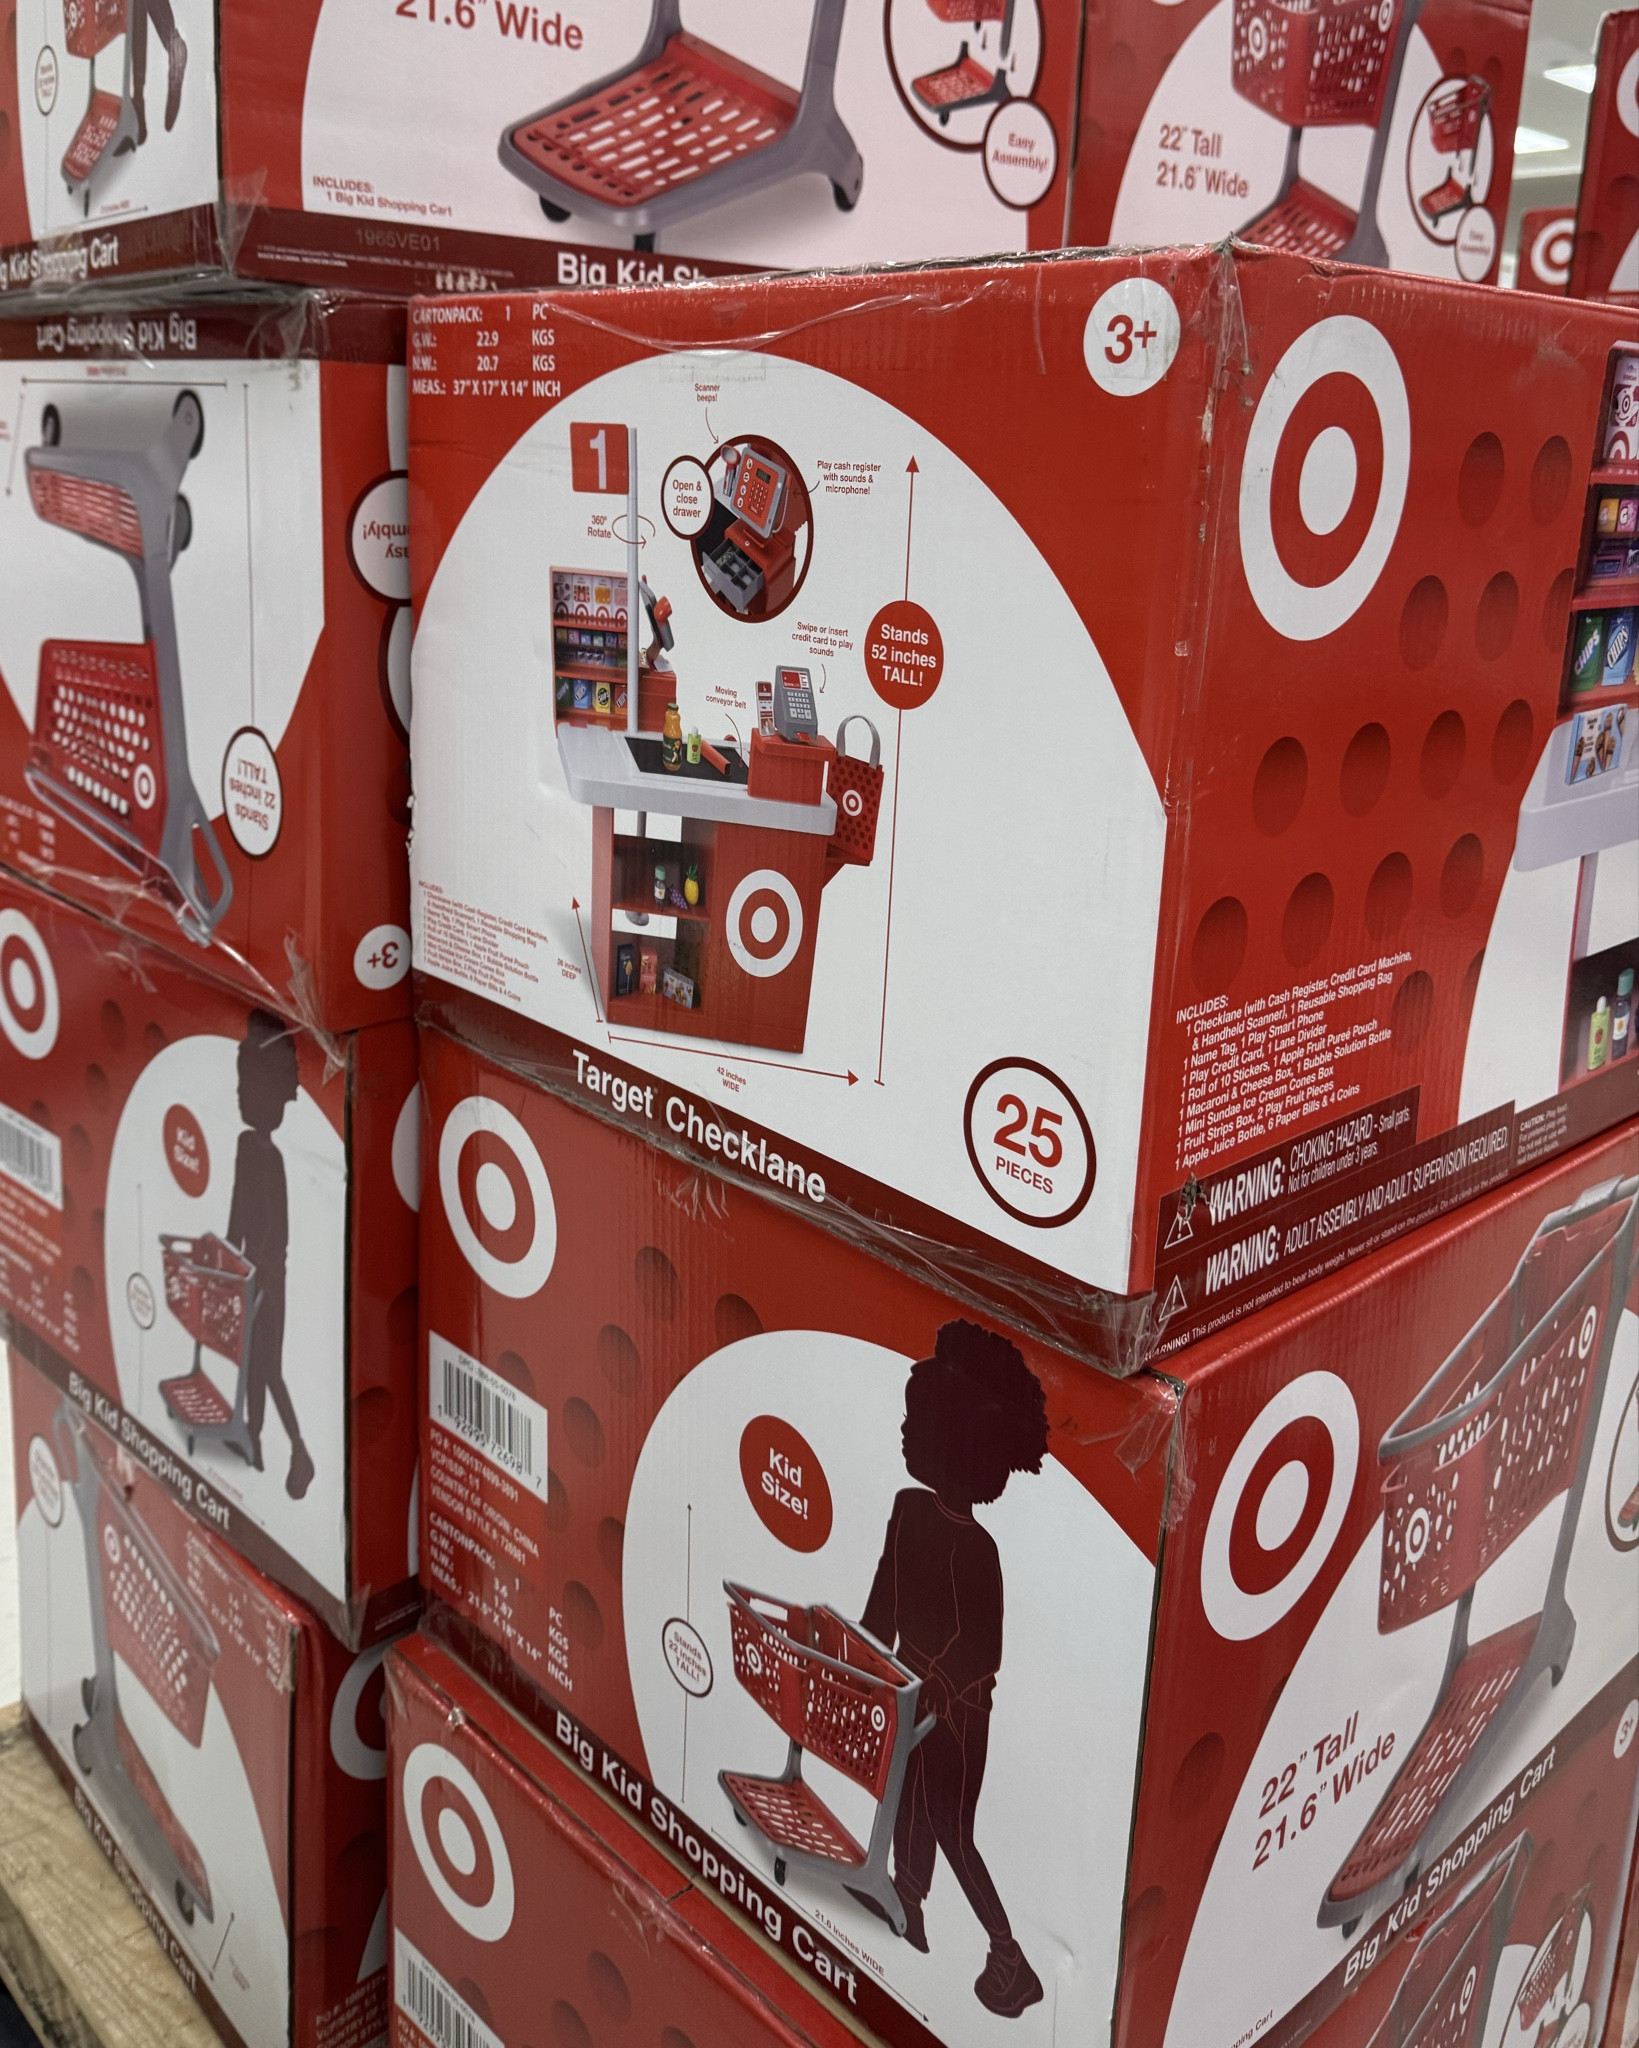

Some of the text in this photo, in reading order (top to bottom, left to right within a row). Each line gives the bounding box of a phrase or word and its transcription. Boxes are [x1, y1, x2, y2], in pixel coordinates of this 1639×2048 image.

[495, 1, 585, 51] Wide
[1008, 132, 1035, 153] Easy
[1191, 129, 1223, 158] Tall
[992, 152, 1049, 172] Assembly!
[312, 176, 375, 194] INCLUDES:
[1205, 169, 1250, 199] Wide
[336, 192, 354, 207] Big
[356, 194, 375, 208] Kid
[377, 195, 426, 216] Shopping
[429, 200, 454, 218] Cart
[356, 228, 441, 253] 1965VE01
[557, 252, 665, 286] Big Kid
[412, 305, 547, 324] CARTONPACK: 1 PC
[138, 317, 166, 350] Kid
[169, 312, 197, 351] Big
[476, 331, 499, 347] 22.9
[532, 329, 555, 346] KGS
[1104, 314, 1158, 365] 3+
[412, 355, 556, 372] N.W.: 20.7 KGS
[412, 379, 446, 396] MEAS.:
[472, 380, 479, 395] X
[501, 381, 508, 397] X
[532, 380, 561, 397] INCH
[694, 383, 720, 393] Scanner
[696, 393, 718, 403] beeps!
[589, 429, 607, 490] 1
[817, 460, 881, 473] Play cash register
[672, 479, 702, 492] Open &
[823, 472, 874, 484] with sounds &
[825, 483, 871, 496] microphone!
[672, 505, 701, 519] drawer
[676, 493, 698, 505] close
[587, 526, 612, 539] Rotate
[791, 632, 854, 651] credit card to play
[797, 621, 849, 637] Swipe or insert
[880, 623, 929, 645] Stands
[809, 646, 834, 657] sounds
[871, 643, 937, 668] 52 inches
[1606, 625, 1630, 669] CHIPS
[882, 665, 924, 687] TALL!
[705, 694, 747, 710] conveyor belt
[715, 684, 738, 699] Moving
[237, 758, 267, 784] TALL!
[235, 803, 269, 831] Stands
[367, 940, 400, 970] 3+
[1193, 1008, 1242, 1034] Checklane
[1244, 997, 1266, 1017] (with
[1267, 989, 1290, 1007] Cash
[1291, 978, 1328, 999] Register,
[1330, 967, 1356, 986] Credit
[1356, 959, 1377, 977] Card
[1377, 951, 1412, 970] Machine,
[1176, 994, 1229, 1024] INCLUDES:
[1201, 1019, 1245, 1048] Handheld
[1246, 1004, 1288, 1031] Scanner),
[1297, 989, 1336, 1013] Reusable
[1337, 977, 1376, 998] Shopping
[1376, 971, 1393, 985] Bag
[1190, 1049, 1218, 1068] Name
[1220, 1042, 1238, 1056] Tag,
[1247, 1030, 1267, 1046] Play
[1268, 1018, 1296, 1038] Smart
[1296, 1010, 1324, 1028] Phone
[717, 1066, 747, 1086] 42 inches
[722, 1077, 741, 1093] WIDE
[572, 1049, 826, 1203] Target Checklane
[993, 1093, 1063, 1168] 25
[995, 1155, 1053, 1195] PIECES
[1209, 1156, 1285, 1227] WARNING:
[1290, 1129, 1335, 1172] CHOKING
[1335, 1113, 1373, 1155] HAZARD
[1379, 1111, 1394, 1134] Small
[1394, 1107, 1411, 1132] parts.
[1287, 1141, 1378, 1194] Not for children under 3 years.
[1205, 1224, 1281, 1296] WARNING:
[1284, 1217, 1316, 1256] ADULT
[1316, 1195, 1365, 1241] ASSEMBLY
[1363, 1185, 1384, 1216] AND
[1383, 1170, 1414, 1206] ADULT
[1413, 1145, 1468, 1192] SUPERVISION
[1467, 1126, 1508, 1165] REQUIRED.
[69, 1371, 92, 1413] Big
[94, 1394, 119, 1430] Kid
[121, 1415, 192, 1502] Shopping
[195, 1480, 230, 1530] Cart
[769, 1447, 802, 1488] Kid
[761, 1471, 808, 1520] Size!
[668, 1640, 707, 1677] 22 inches
[673, 1631, 702, 1661] Stands
[675, 1657, 701, 1682] TALL!
[1313, 1710, 1359, 1775] Tall
[1332, 1732, 1396, 1804] Wide
[556, 1710, 858, 2004] Big Kid Shopping Cart
[1343, 1747, 1557, 1988] Big Kid Shopping Cart
[815, 1909, 885, 1977] 21.6 inches WIDE
